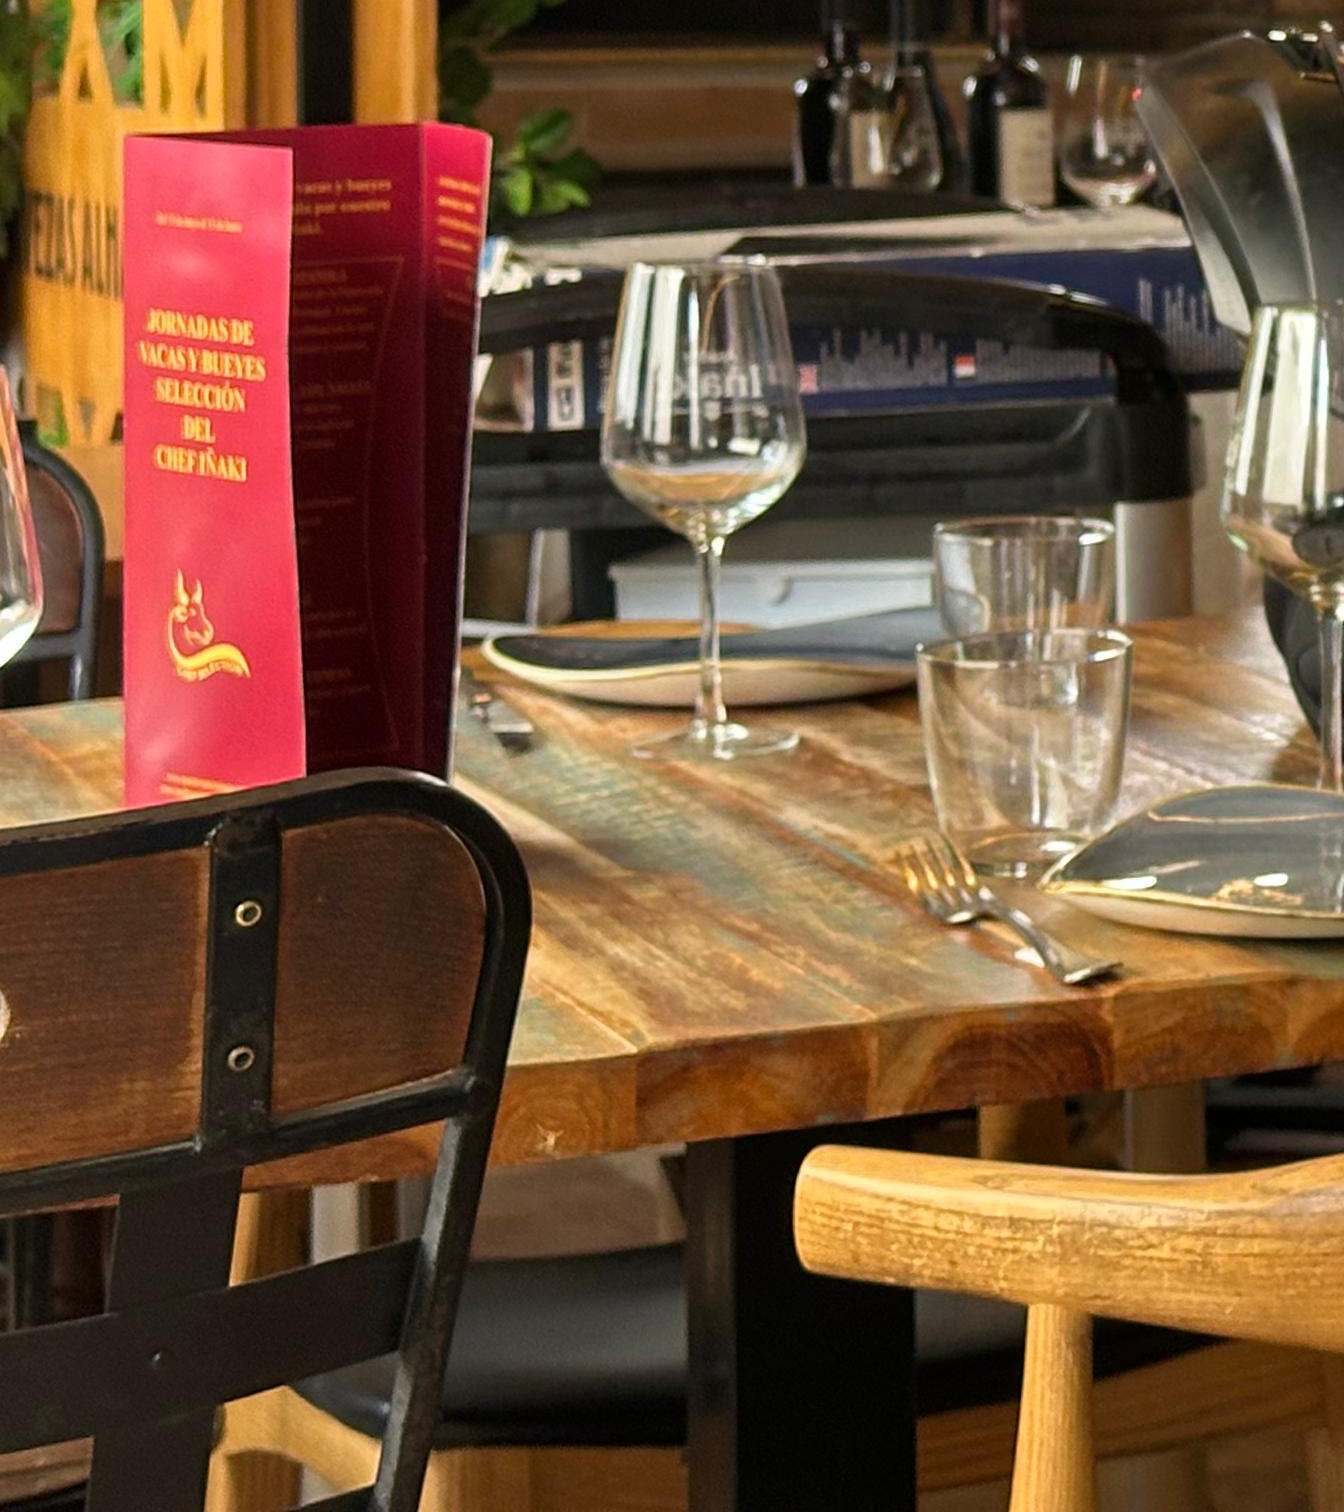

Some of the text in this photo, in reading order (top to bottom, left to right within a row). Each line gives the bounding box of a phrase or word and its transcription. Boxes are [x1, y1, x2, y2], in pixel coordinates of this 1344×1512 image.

[147, 307, 255, 346] JORNADAS DE
[139, 340, 186, 371] VACAS
[187, 347, 200, 372] Y
[201, 349, 266, 382] BUEYES
[155, 376, 246, 413] SELECCIÓN
[181, 414, 216, 444] DEL
[155, 443, 247, 482] CHEF IÑAKI
